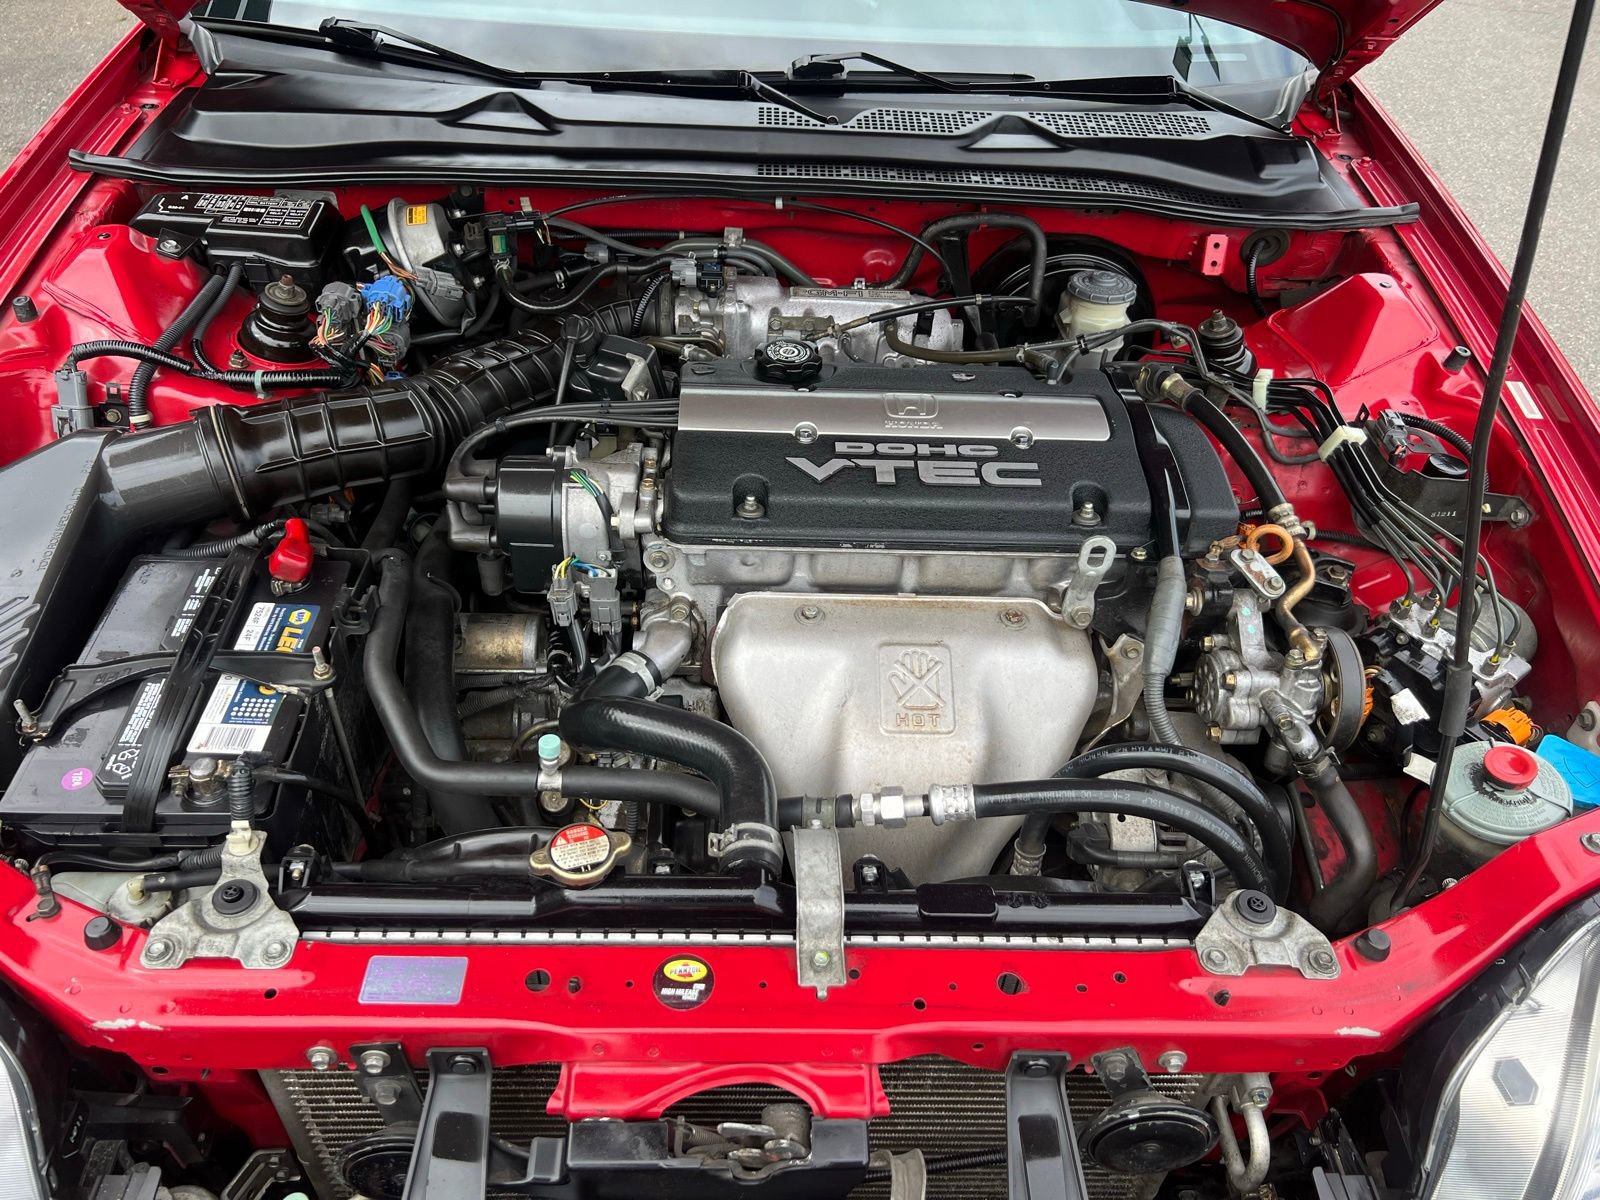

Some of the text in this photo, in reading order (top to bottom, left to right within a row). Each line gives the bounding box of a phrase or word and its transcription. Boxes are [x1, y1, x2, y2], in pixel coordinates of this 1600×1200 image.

[884, 420, 944, 430] HONDA
[834, 441, 999, 458] DOHC
[784, 456, 1042, 487] VTEC
[243, 629, 255, 641] 24F
[896, 713, 941, 727] HOT
[581, 864, 592, 873] 1.1
[669, 966, 701, 975] PENNZOIL
